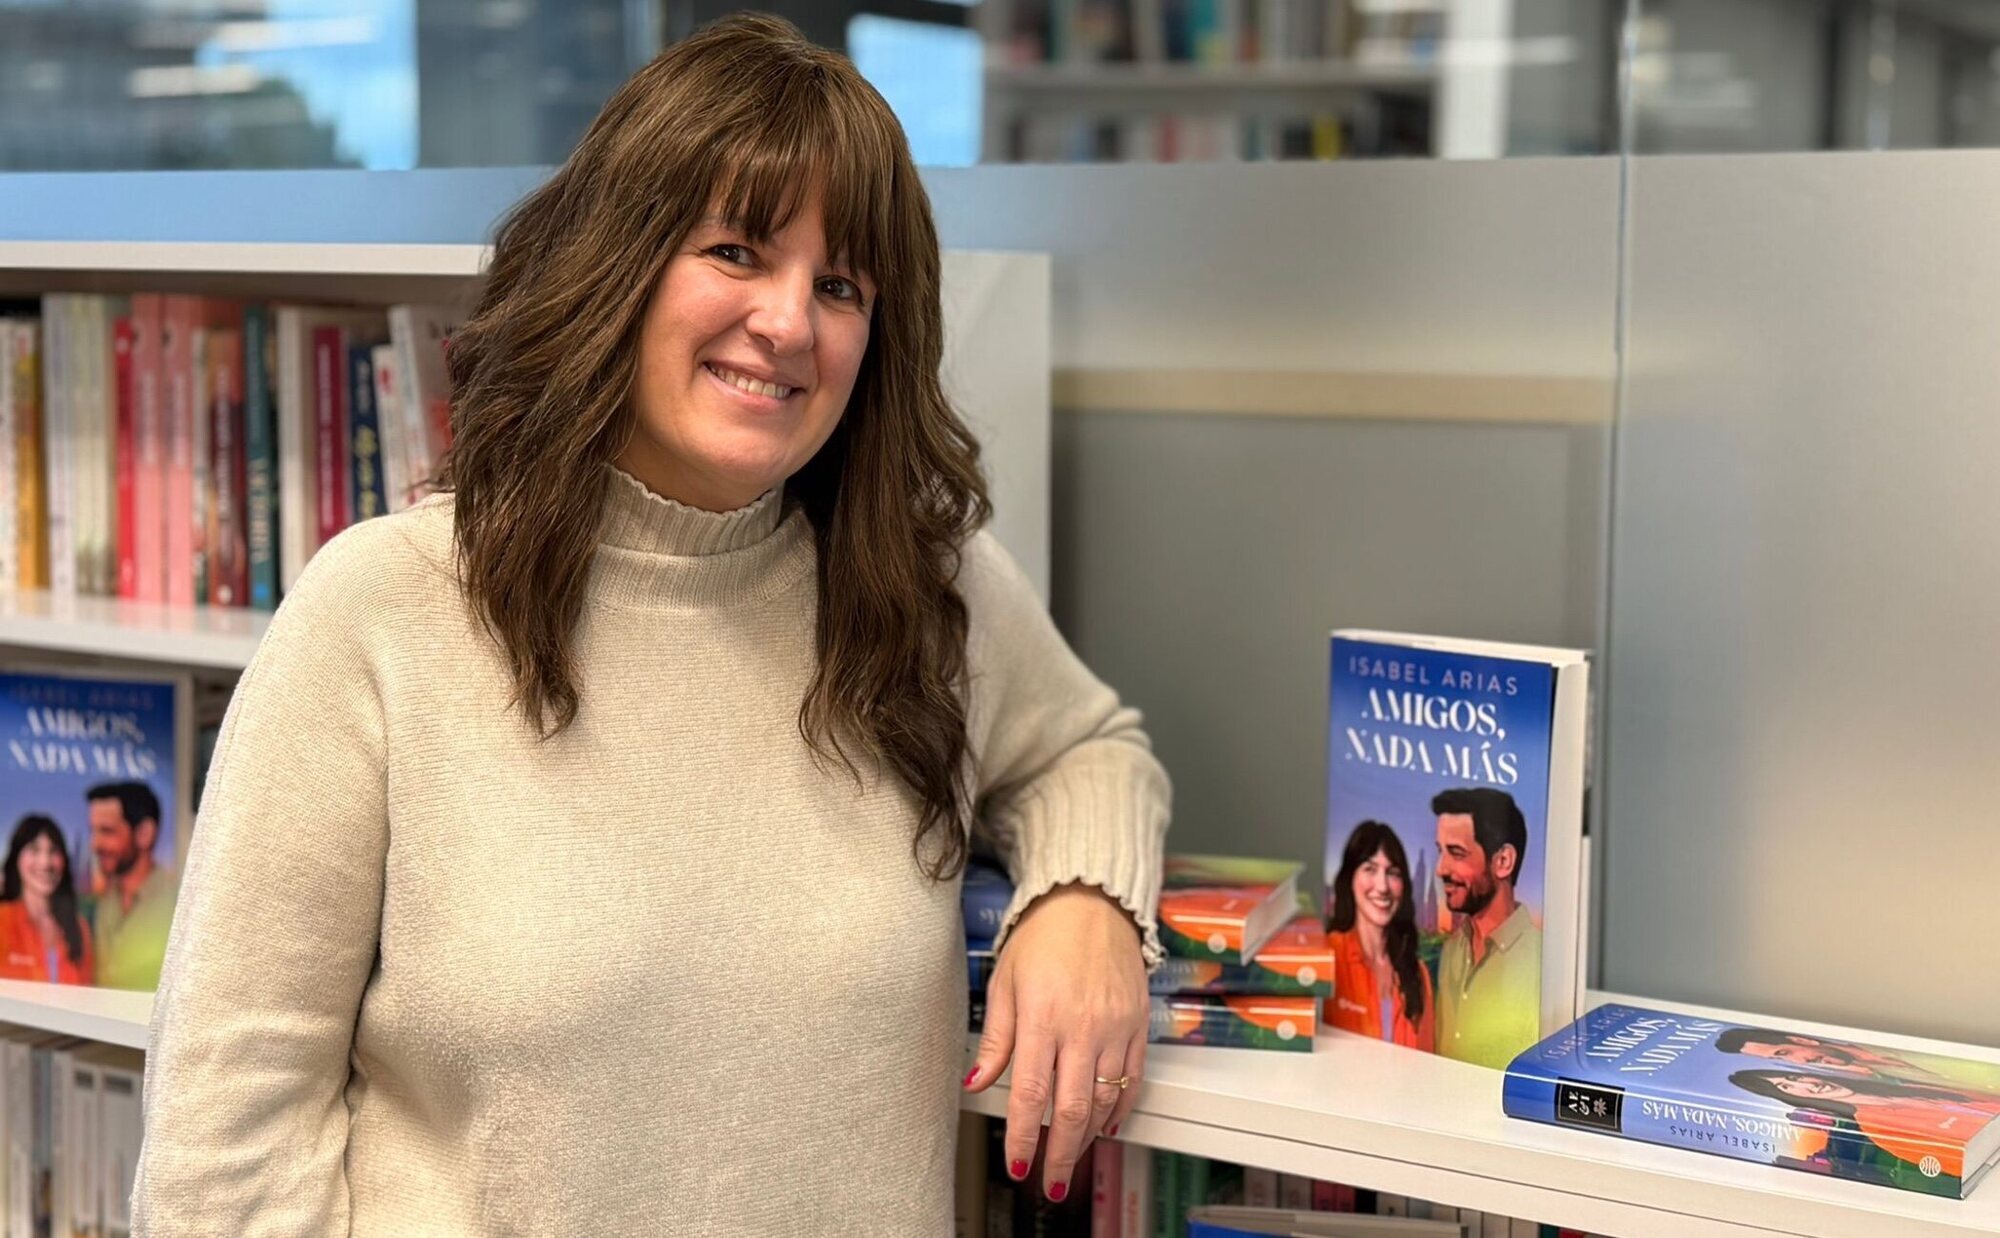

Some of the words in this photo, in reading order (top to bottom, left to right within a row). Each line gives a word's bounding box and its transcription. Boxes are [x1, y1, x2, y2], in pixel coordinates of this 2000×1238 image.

[1349, 656, 1430, 685] ISABEL
[1441, 669, 1518, 696] ARIAS
[1361, 687, 1506, 740] AMIGOS,
[8, 738, 87, 776] NADA
[1345, 726, 1433, 774] NADA
[1441, 741, 1519, 785] MÁS
[1543, 1028, 1592, 1061] ISABEL
[1586, 1016, 1677, 1063] AMIGOS,
[1620, 1043, 1691, 1076] NADA
[1667, 1019, 1726, 1047] MÁS
[1642, 1100, 1679, 1121] MÁS
[1683, 1105, 1728, 1129] NADA
[1732, 1112, 1801, 1142] AMIGOS,
[1669, 1124, 1715, 1143] ARIAS
[1723, 1134, 1775, 1153] ISABEL
